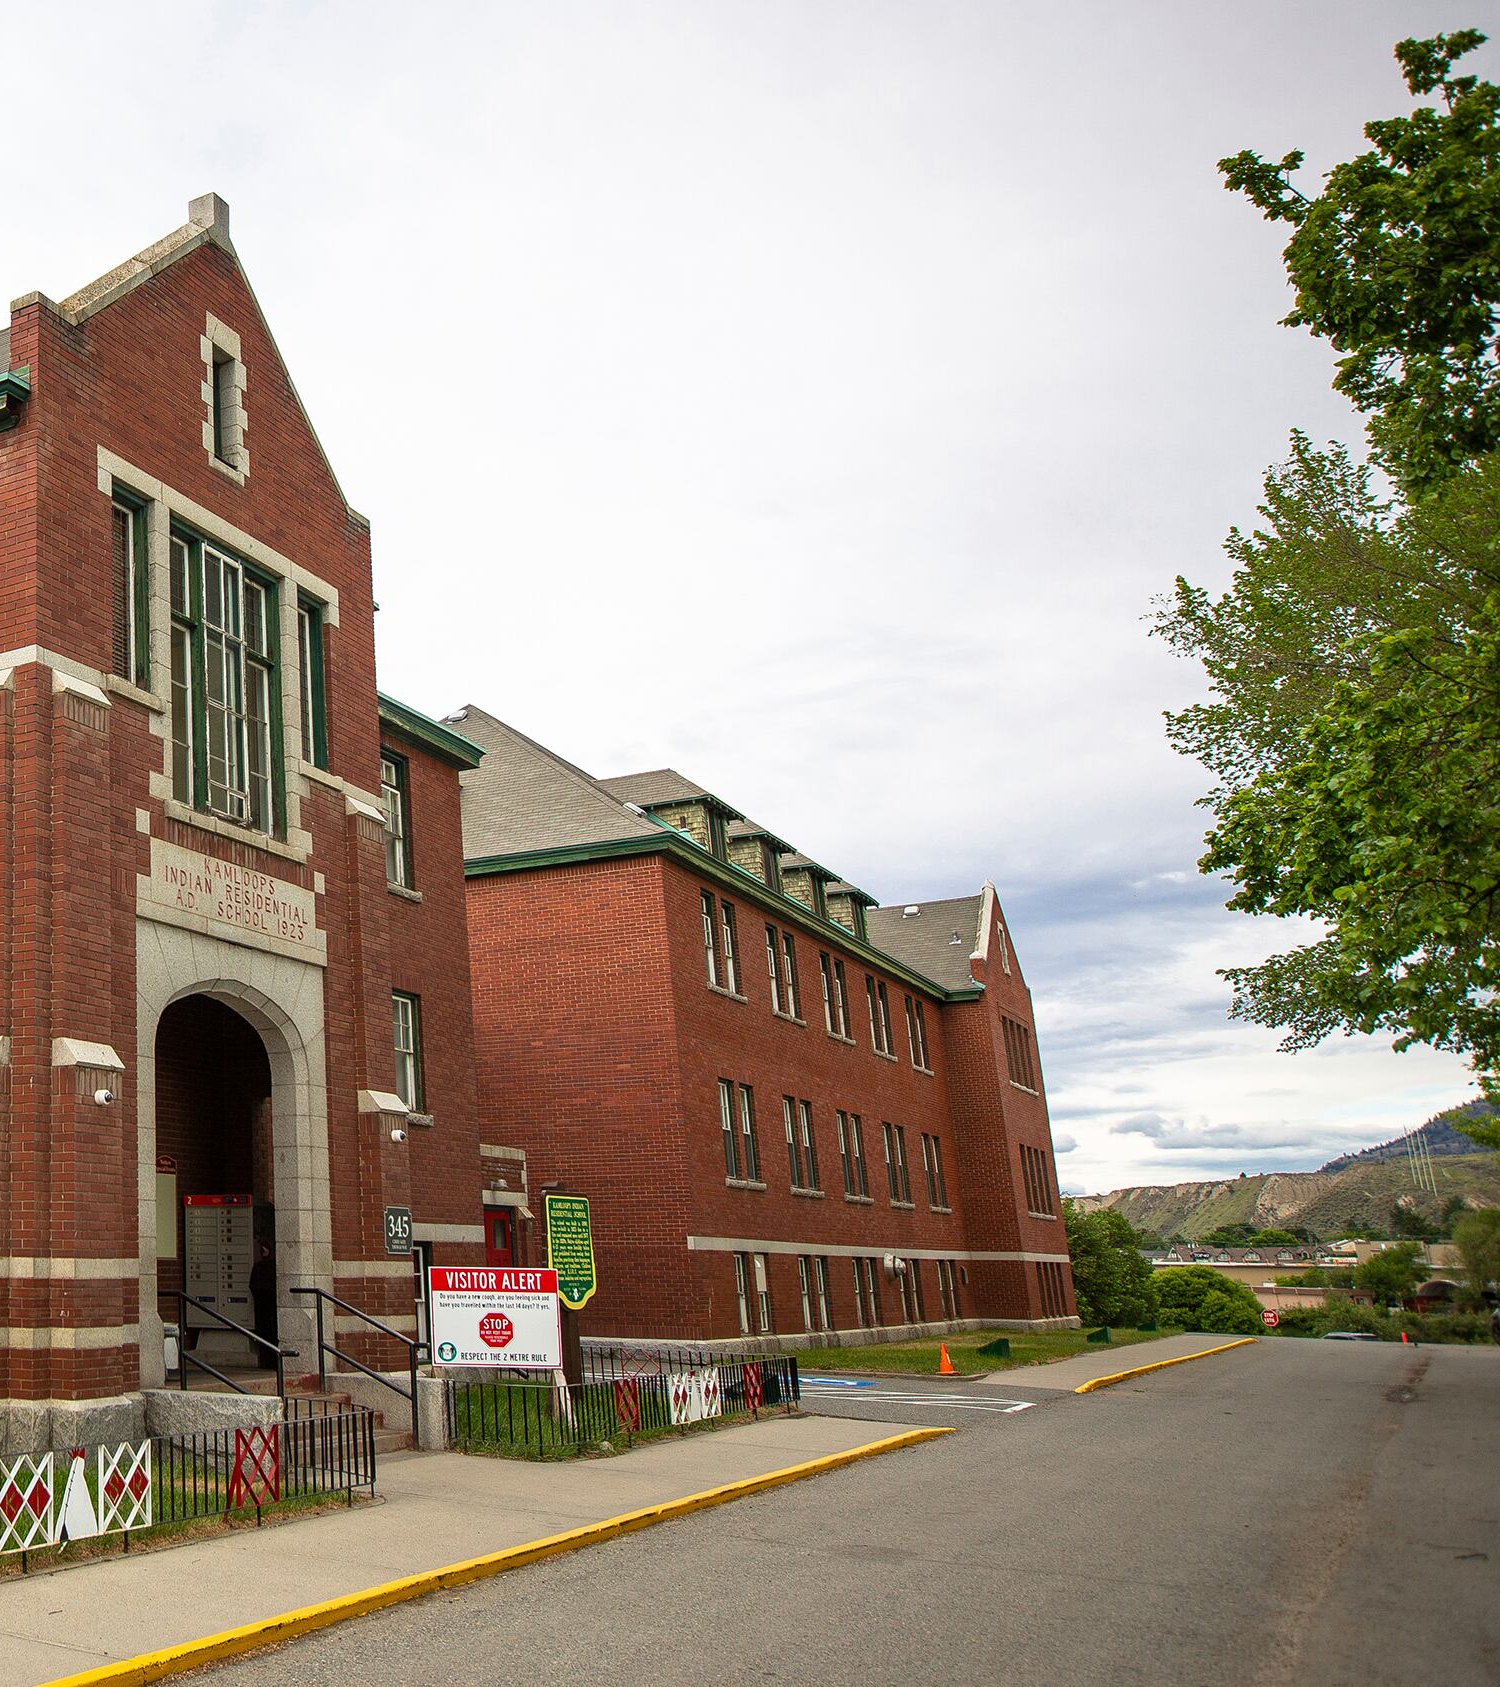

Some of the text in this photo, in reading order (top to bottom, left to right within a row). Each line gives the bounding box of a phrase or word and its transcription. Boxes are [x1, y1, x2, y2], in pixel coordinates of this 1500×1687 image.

[204, 858, 275, 895] KAMLOOPS
[165, 865, 308, 925] INDIAN RESIDENTIAL
[176, 889, 304, 941] A.D. SCHOOL 1923
[187, 1196, 192, 1205] 2
[388, 1215, 409, 1238] 345
[446, 1272, 496, 1289] VISITOR
[502, 1273, 542, 1290] ALERT
[483, 1318, 509, 1330] STOP
[461, 1352, 547, 1362] RESPECT THE 2 METRE RULE
